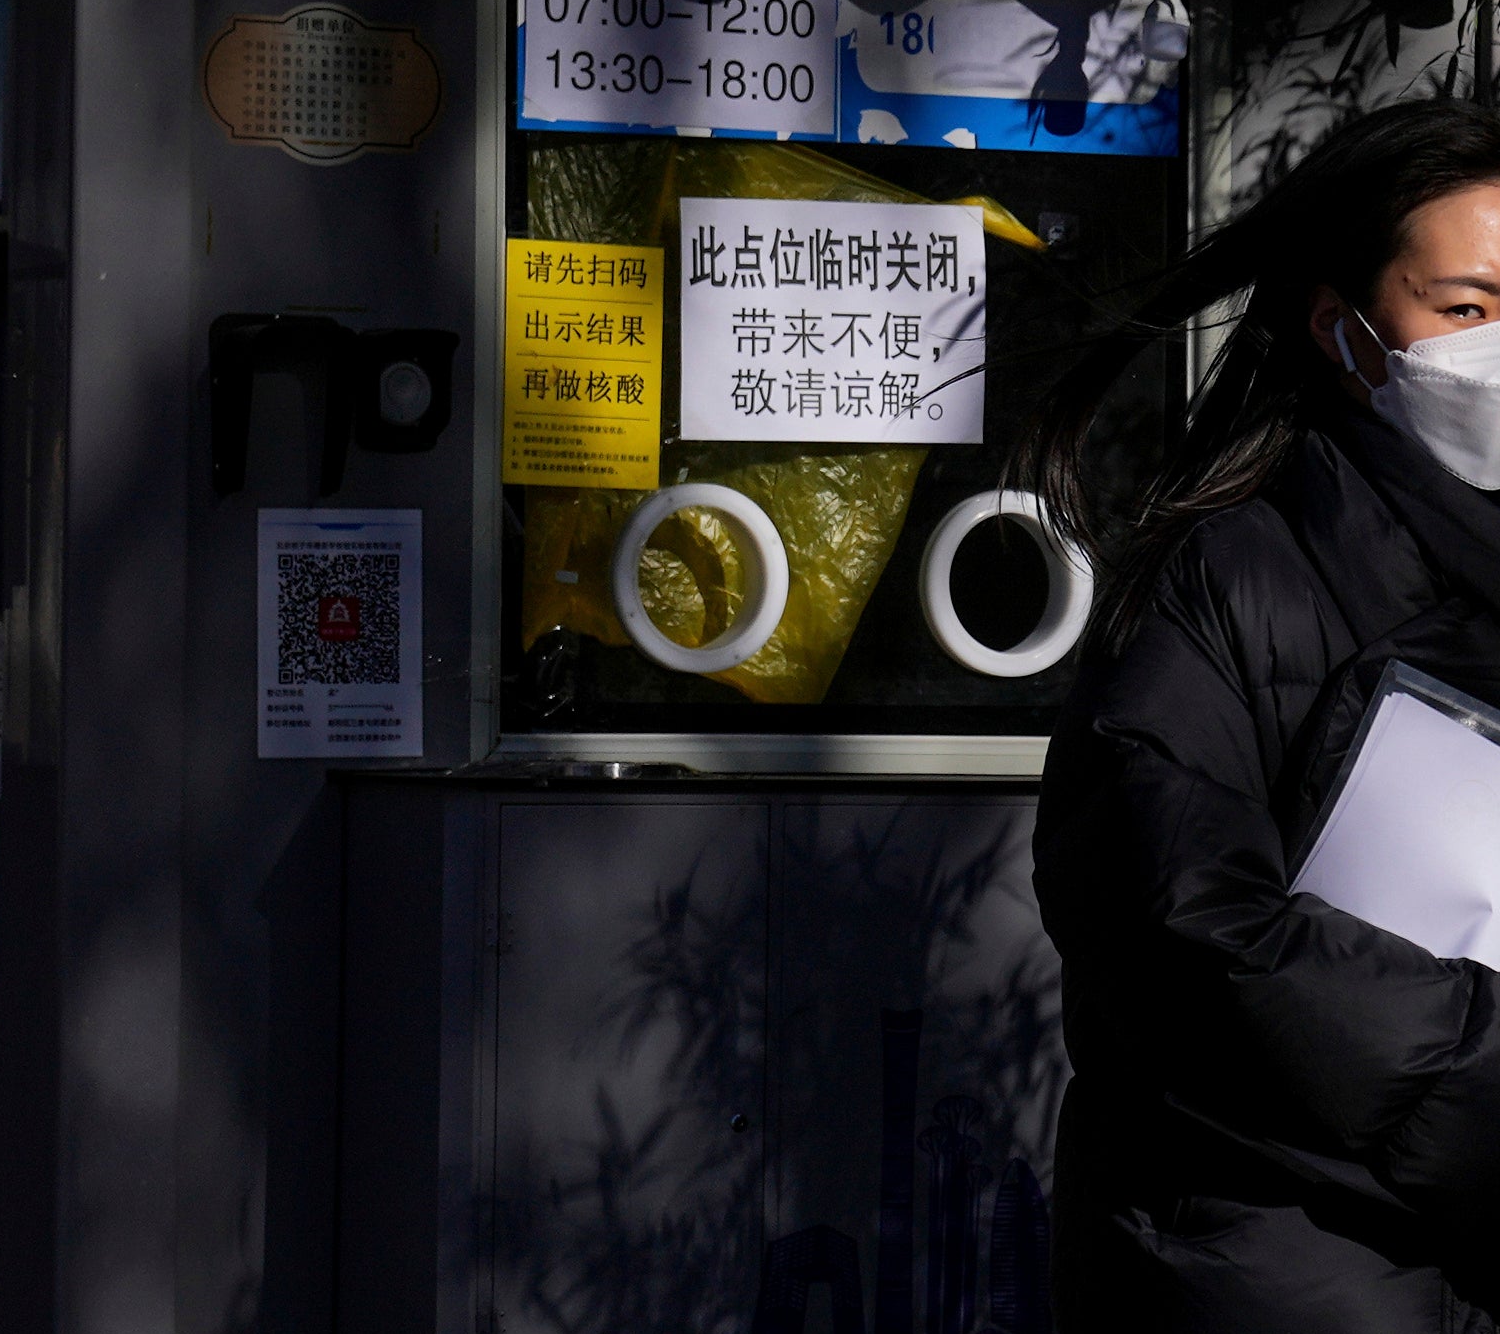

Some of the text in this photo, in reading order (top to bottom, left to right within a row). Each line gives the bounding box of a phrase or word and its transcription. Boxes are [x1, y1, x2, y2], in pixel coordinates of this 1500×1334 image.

[296, 17, 355, 33] 捐赠单位
[545, 49, 815, 104] 13:30-18:00
[524, 250, 648, 289] 请先扫码
[689, 223, 979, 298] 此点位临时关闭，
[524, 311, 647, 349] 出示结果
[732, 308, 942, 362] 带来不便，
[521, 366, 646, 407] 再做核酸
[730, 370, 944, 423] 敬请谅解。
